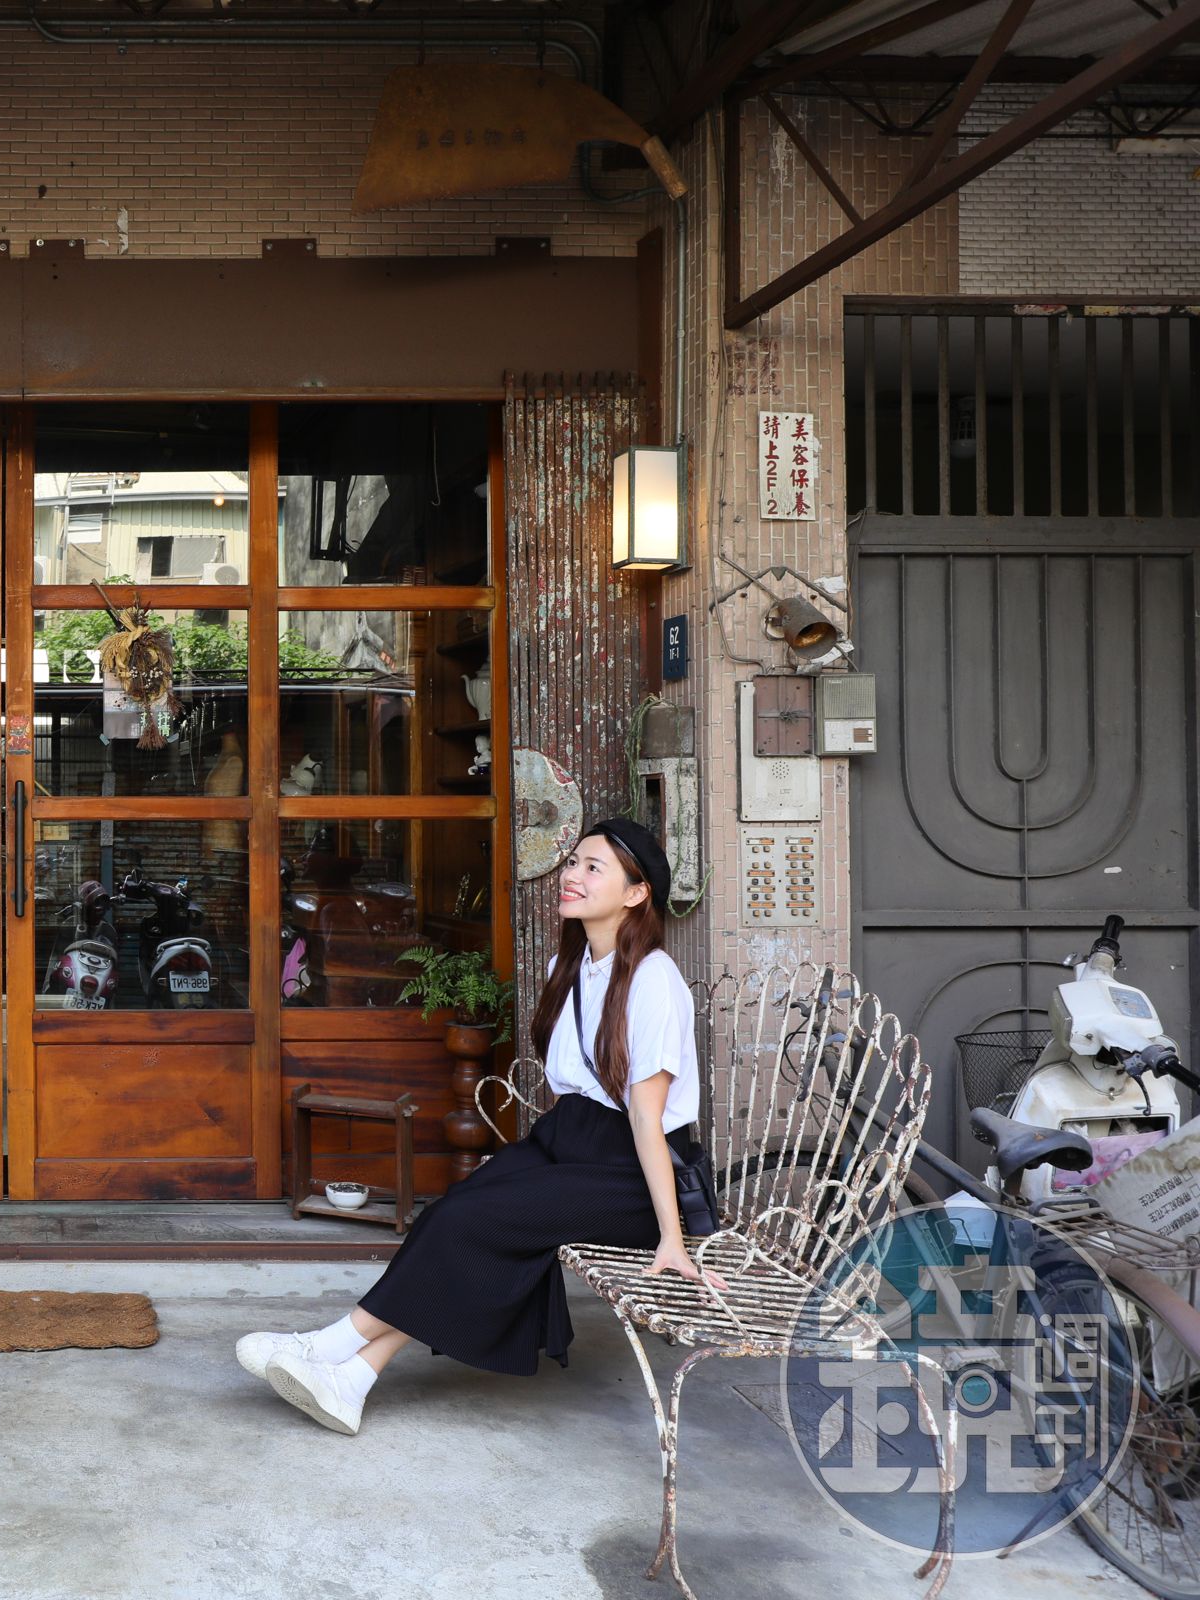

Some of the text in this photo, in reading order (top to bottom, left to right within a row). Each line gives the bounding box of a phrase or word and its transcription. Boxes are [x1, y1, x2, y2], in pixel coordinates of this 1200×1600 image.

[790, 417, 810, 517] 美容保養
[670, 626, 679, 645] 62
